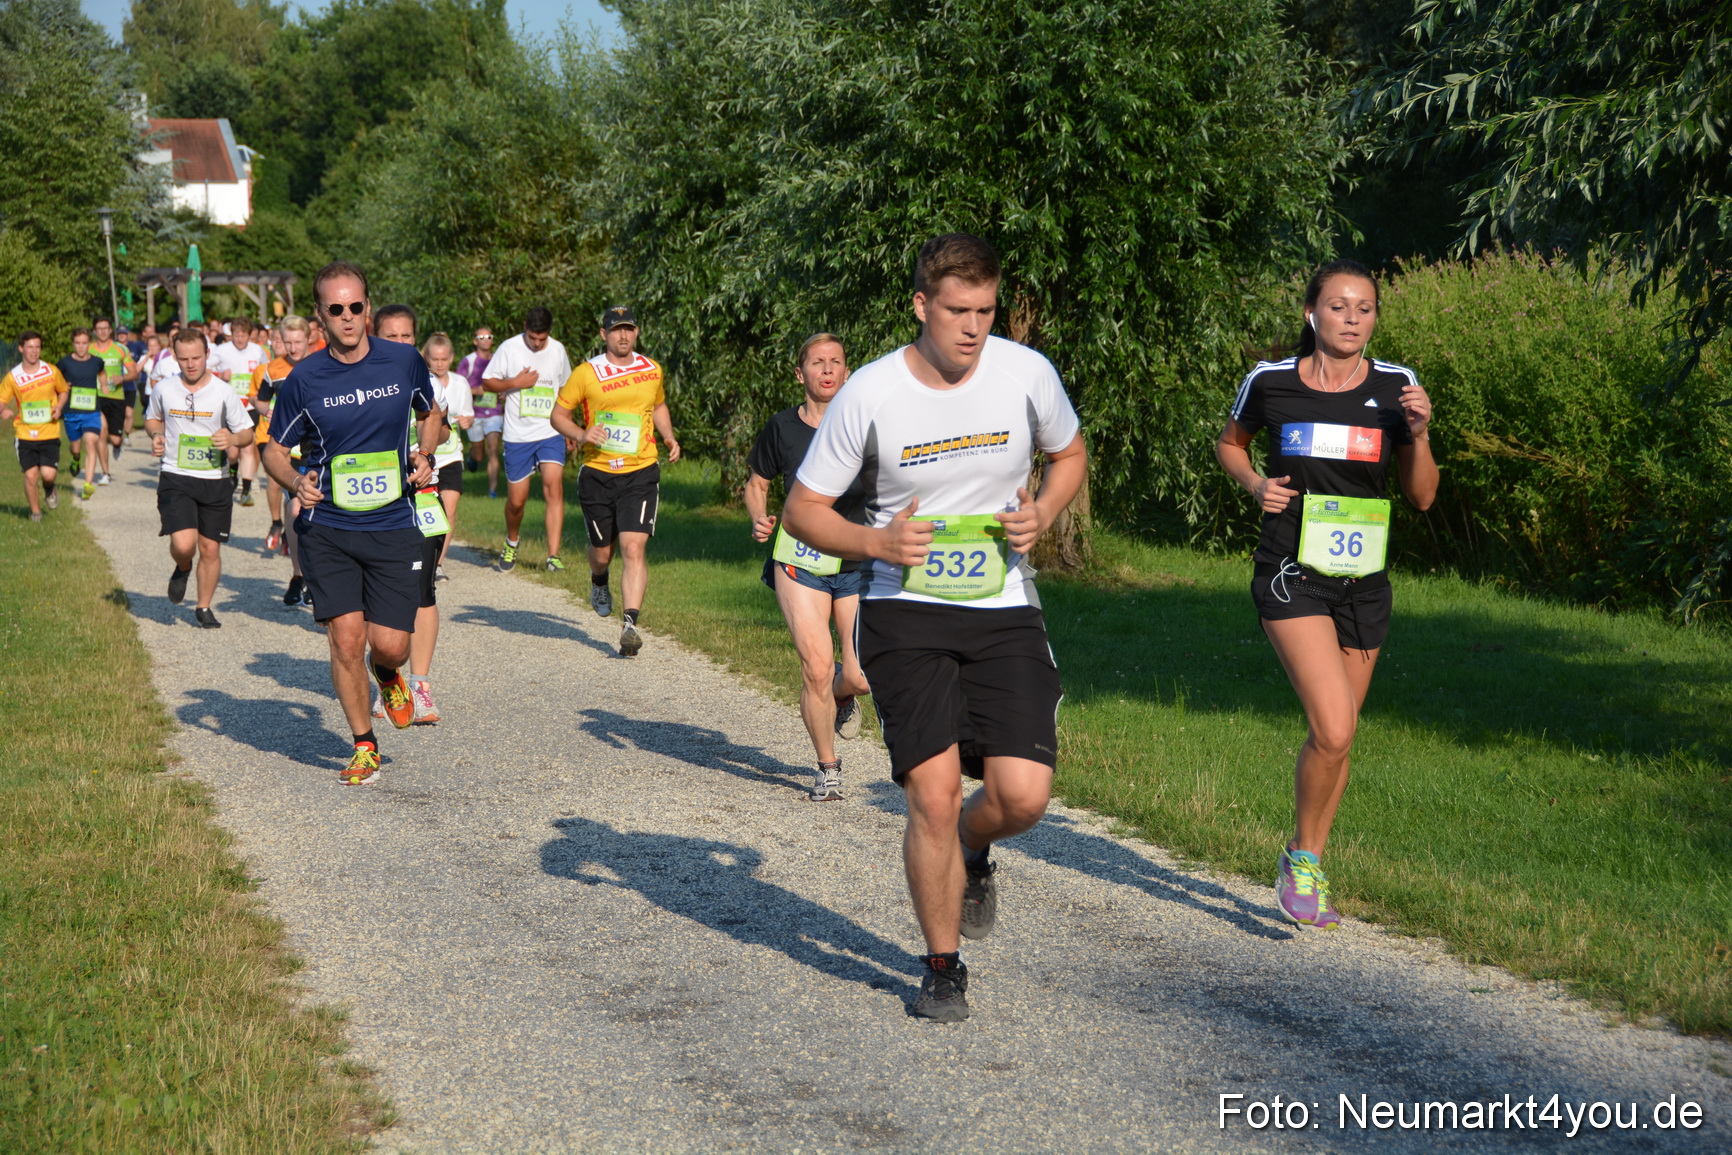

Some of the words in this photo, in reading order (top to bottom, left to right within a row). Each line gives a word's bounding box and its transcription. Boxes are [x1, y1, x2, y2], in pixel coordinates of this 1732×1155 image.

[324, 394, 356, 408] EURO
[366, 384, 400, 401] POLES
[602, 381, 631, 393] MAX
[526, 398, 552, 410] 1470
[28, 410, 46, 418] 941
[901, 431, 1010, 460] grasenhiller
[940, 449, 979, 461] KOMPETENZ
[991, 446, 1009, 454] BÜRO
[1314, 443, 1345, 454] MÜLLER
[347, 475, 388, 496] 365
[1328, 530, 1364, 557] 36
[925, 550, 987, 578] 532
